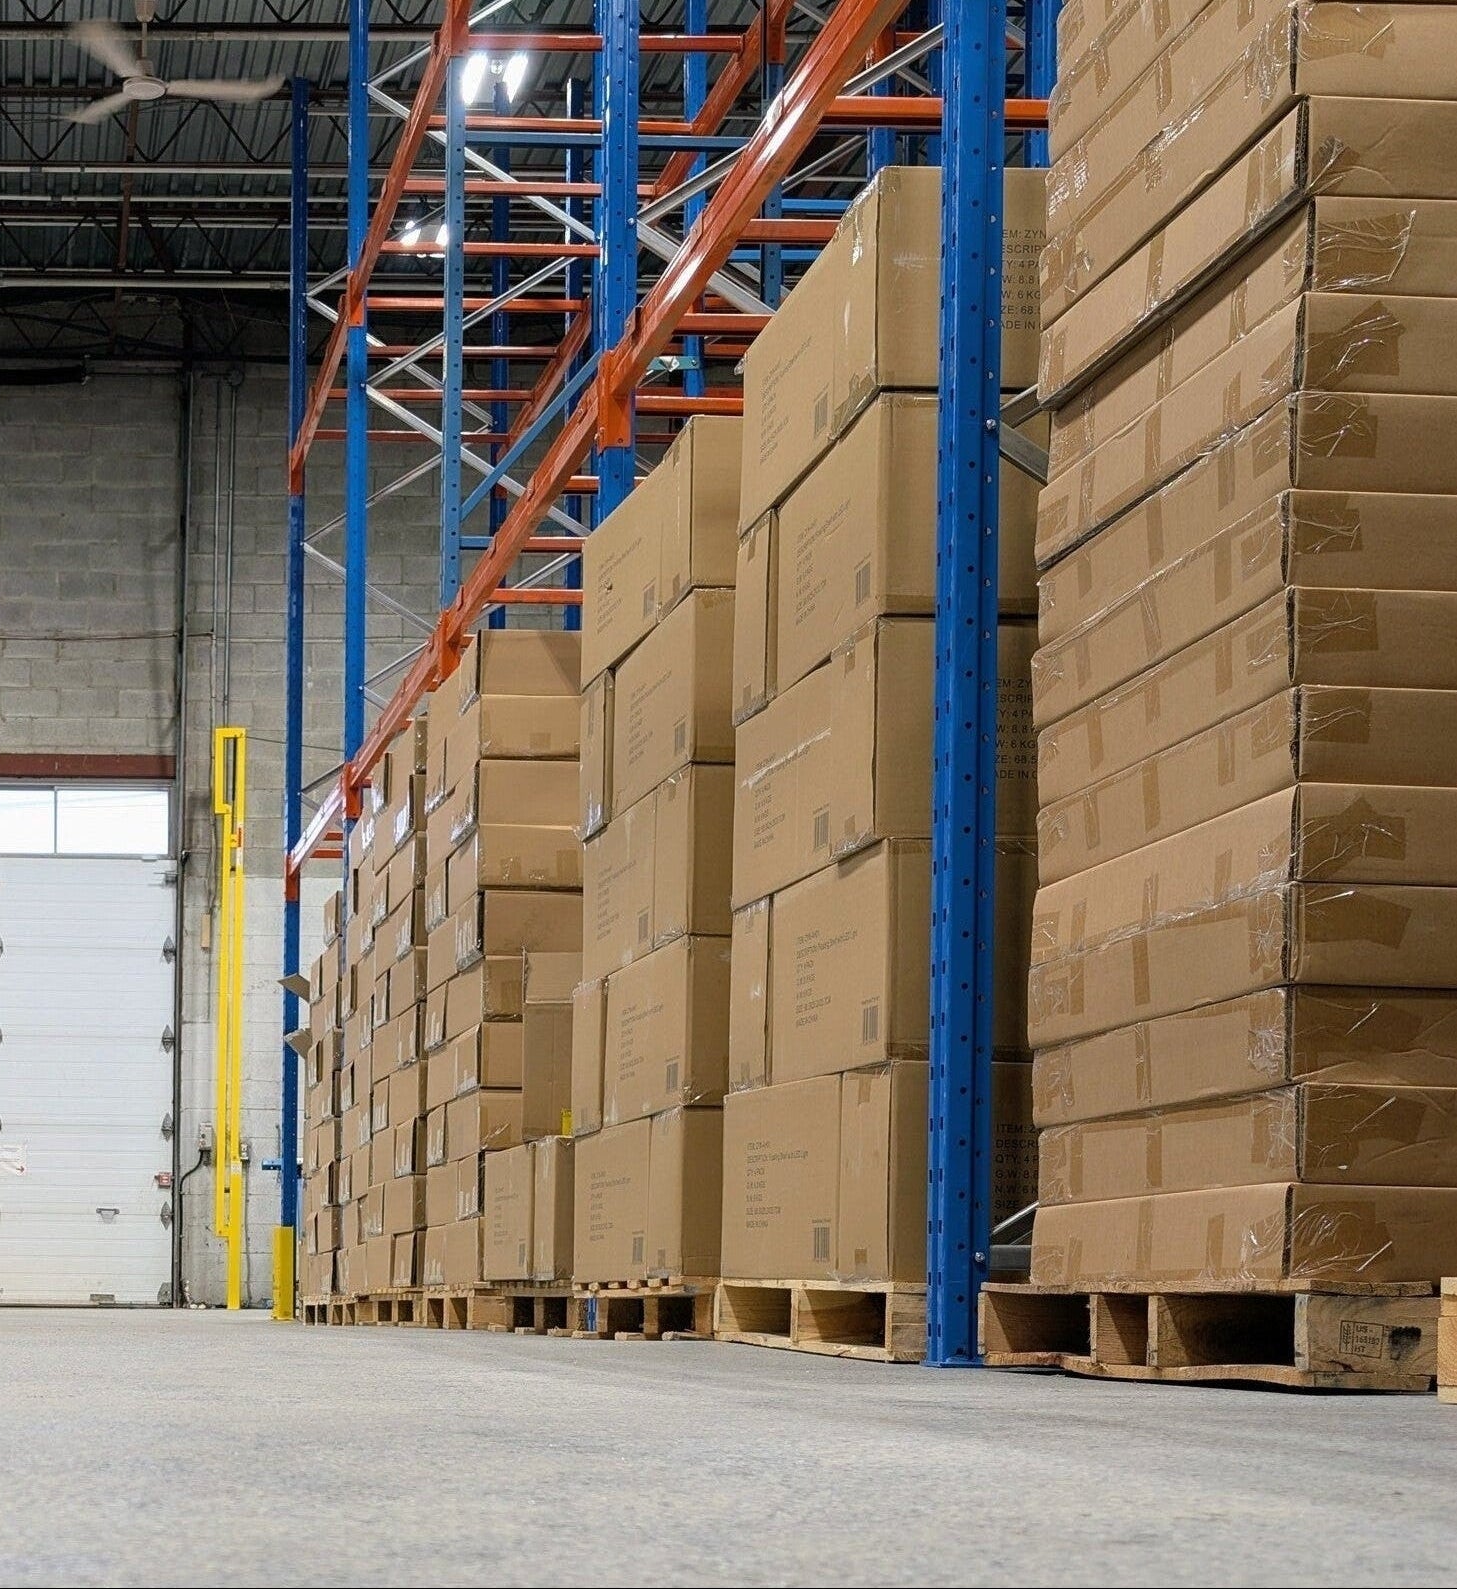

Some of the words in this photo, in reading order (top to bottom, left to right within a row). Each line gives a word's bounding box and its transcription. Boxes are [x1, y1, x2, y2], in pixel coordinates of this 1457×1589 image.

[1020, 306, 1040, 315] 68.
[1025, 320, 1035, 330] IN
[996, 694, 1033, 703] SCRIP
[1018, 770, 1028, 779] IN
